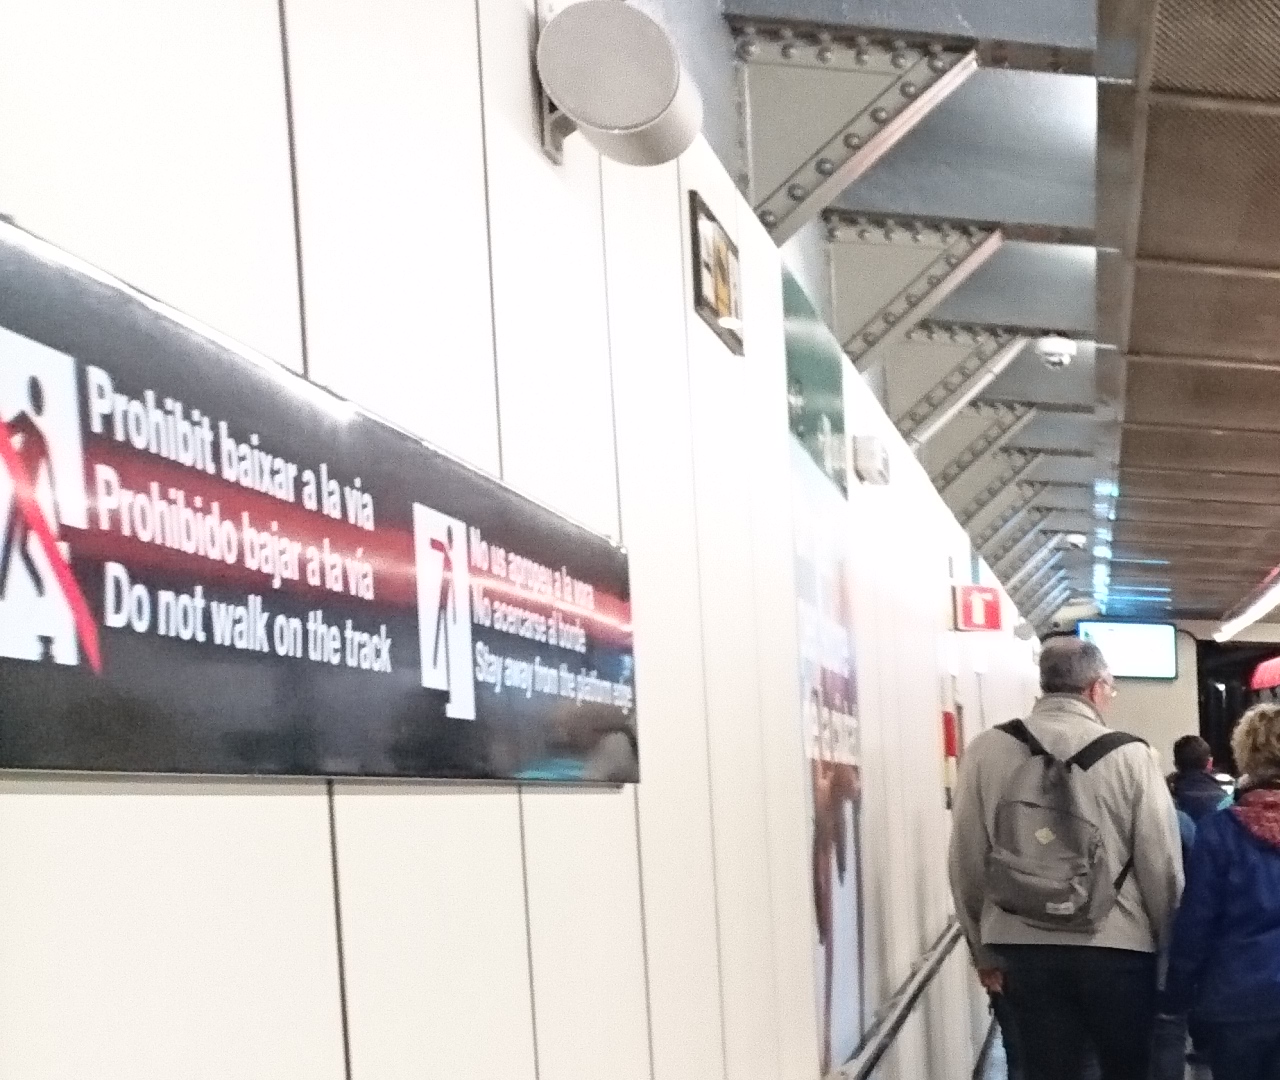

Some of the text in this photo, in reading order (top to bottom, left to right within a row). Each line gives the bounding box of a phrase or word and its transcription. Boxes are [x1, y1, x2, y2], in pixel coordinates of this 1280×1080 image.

[86, 365, 375, 531] Prohibit baixar a la via
[94, 463, 238, 564] Prohibido
[241, 511, 301, 589] bajar
[306, 545, 321, 586] a
[323, 538, 344, 592] la
[469, 526, 489, 571] No
[104, 561, 392, 673] Do not walk on the track
[472, 584, 491, 627] No
[476, 641, 503, 693] Stay
